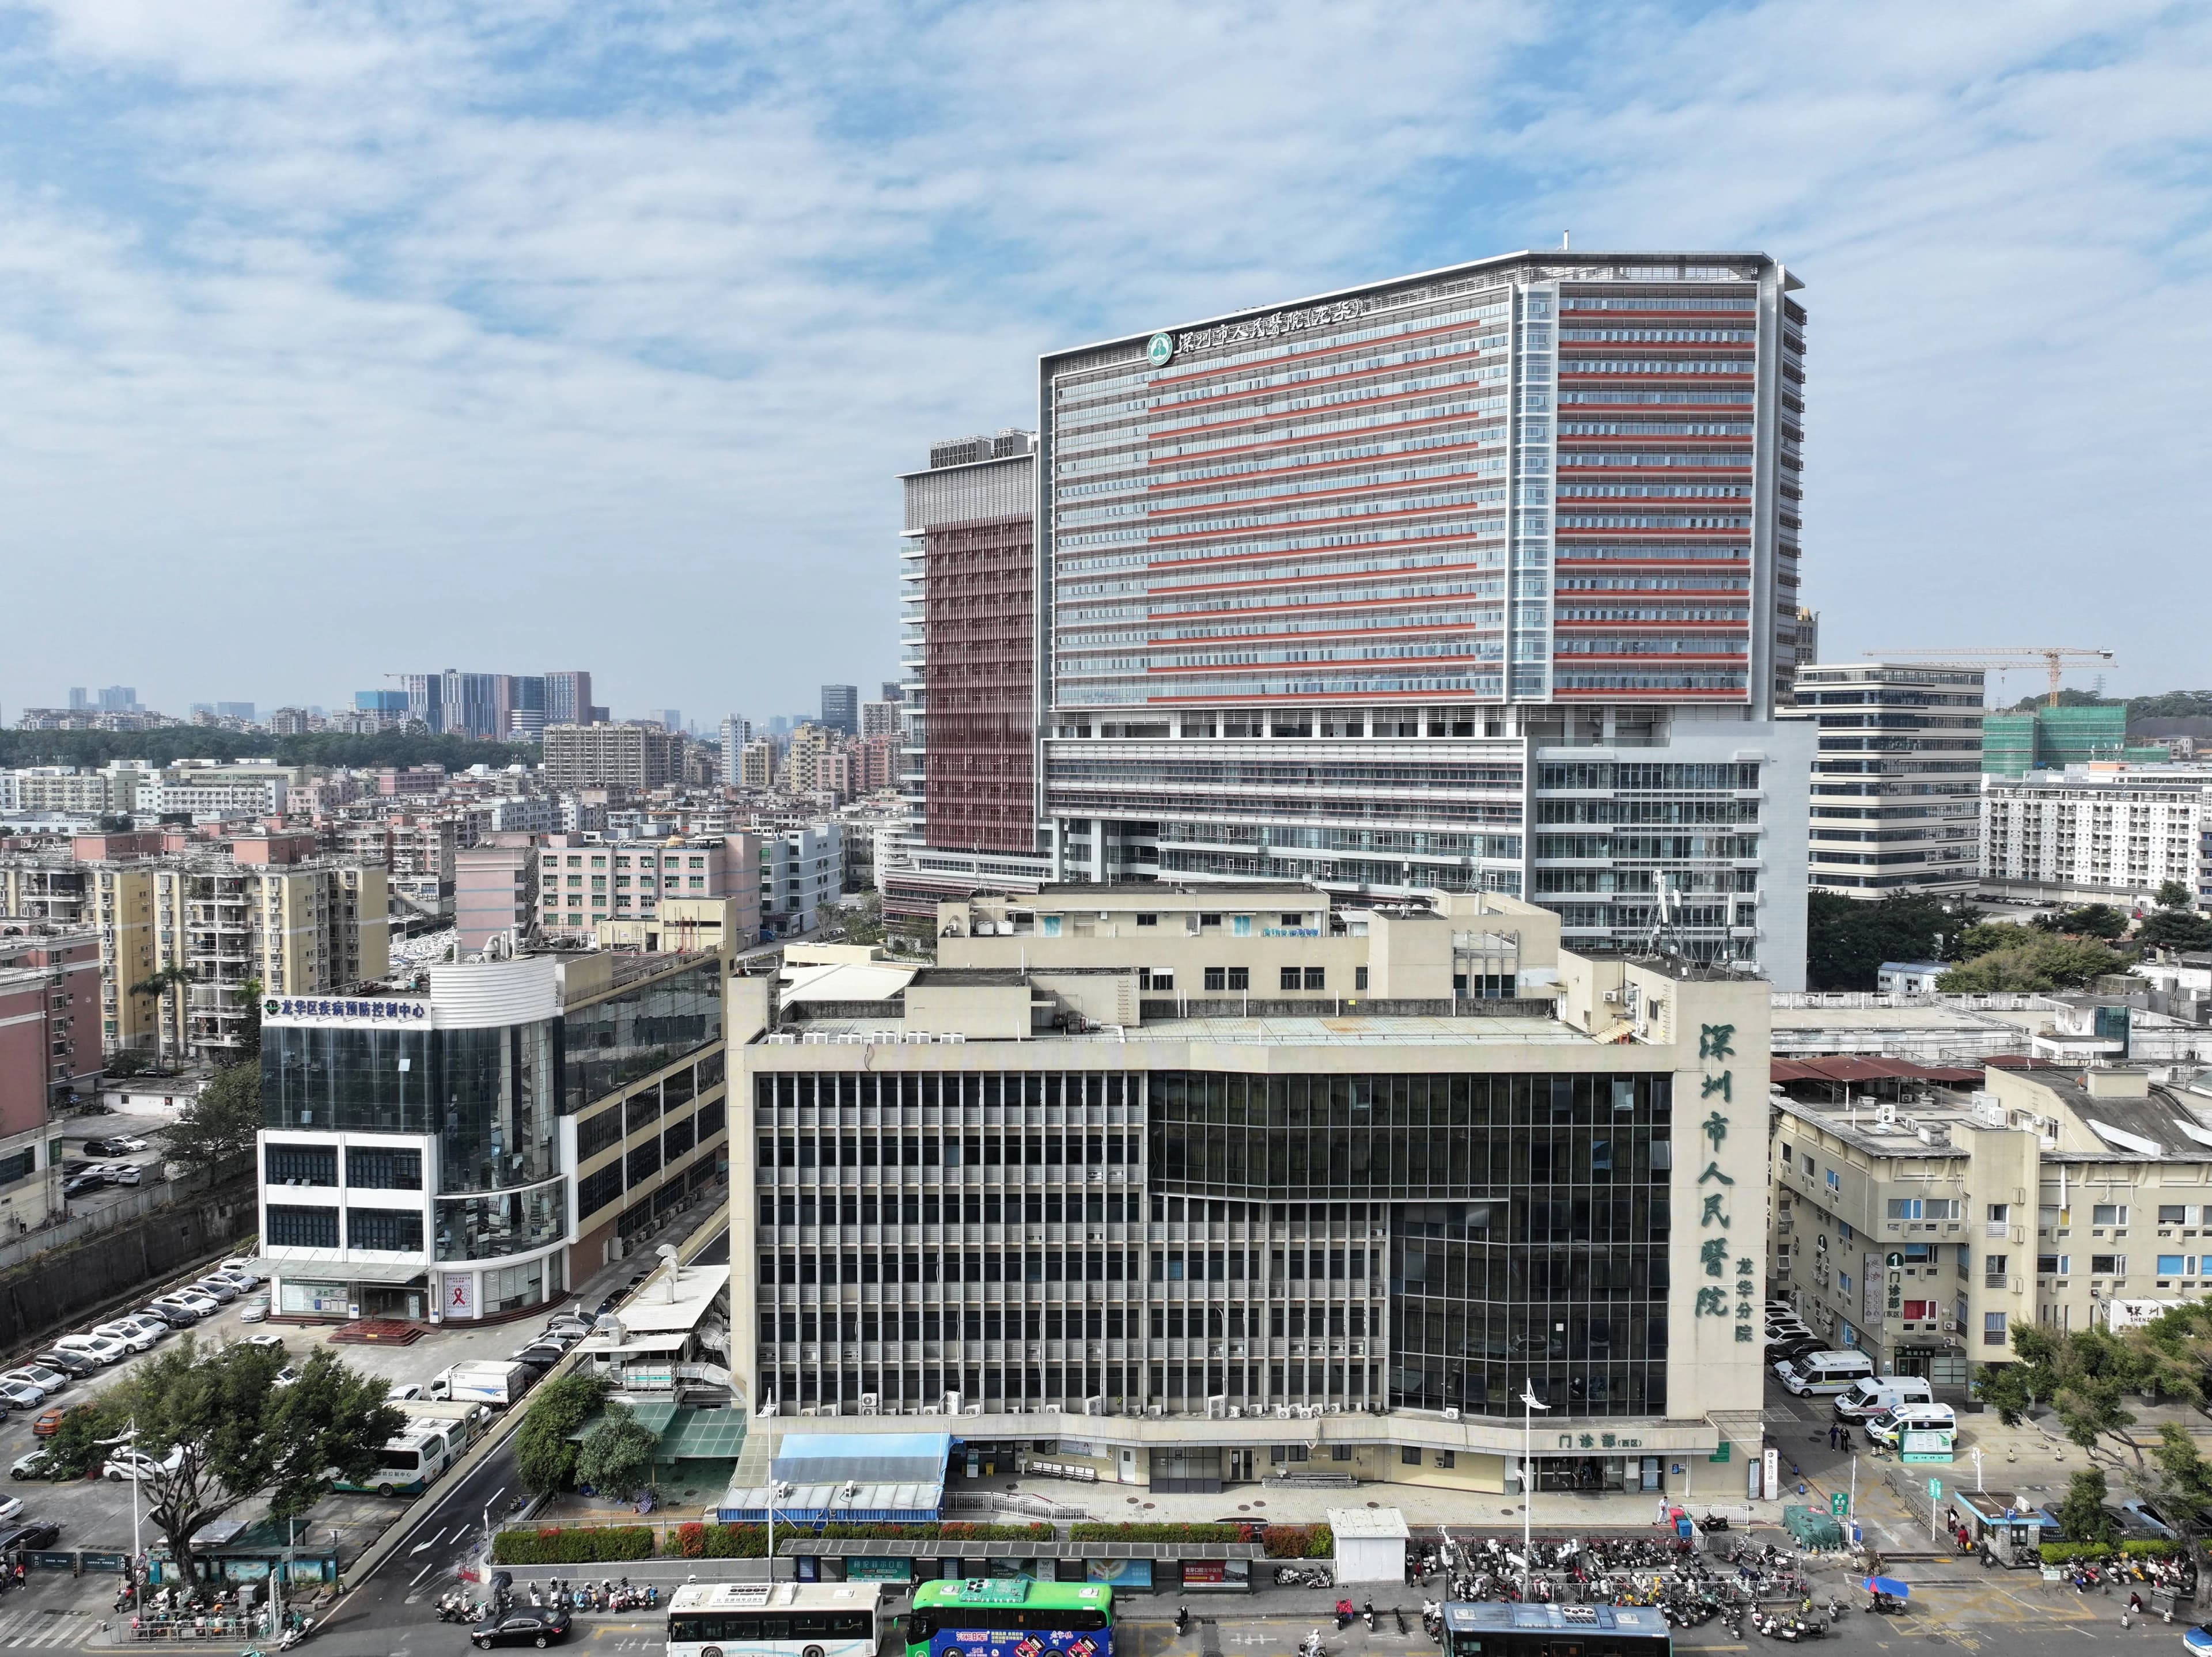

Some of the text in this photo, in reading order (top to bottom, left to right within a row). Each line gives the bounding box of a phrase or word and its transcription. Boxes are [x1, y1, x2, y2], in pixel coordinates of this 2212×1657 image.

[281, 999, 425, 1018] 龙华区疾病预防控制中心
[1820, 1236, 1824, 1246] 1
[1891, 1254, 1898, 1266] 1
[1888, 1271, 1900, 1309] 门诊部
[1735, 1257, 1755, 1343] 龙华分院
[2008, 1510, 2014, 1519] P
